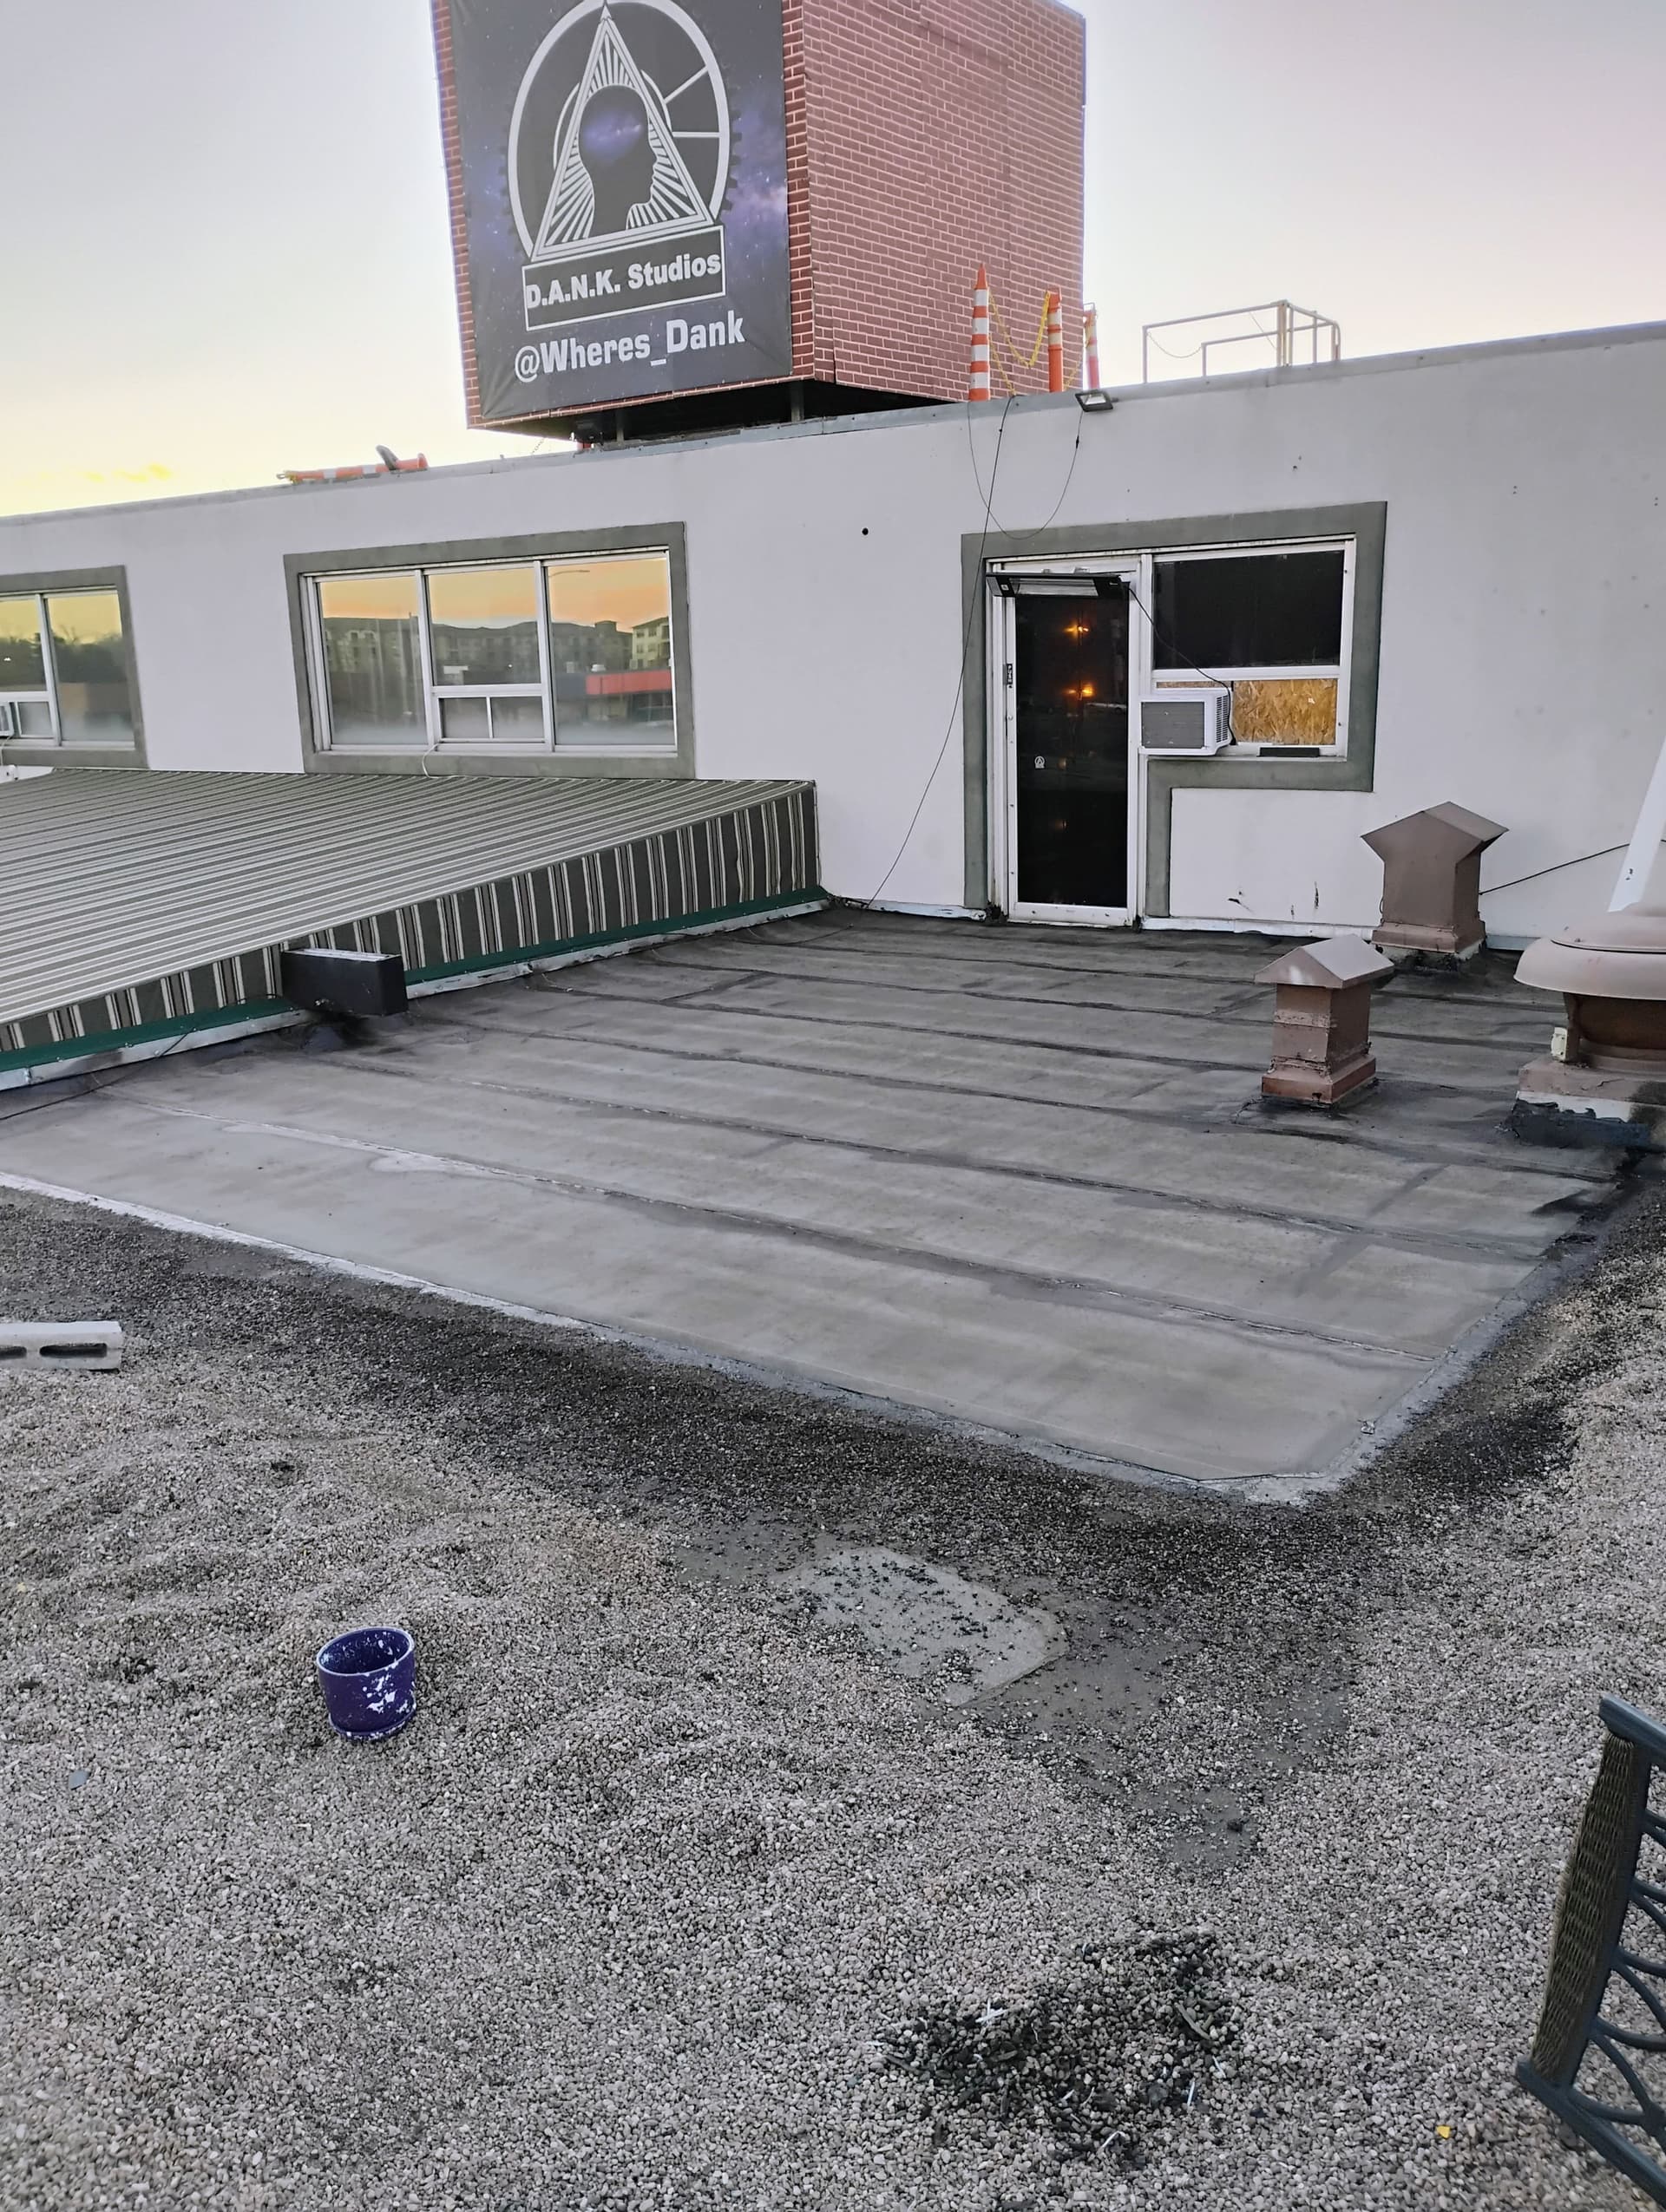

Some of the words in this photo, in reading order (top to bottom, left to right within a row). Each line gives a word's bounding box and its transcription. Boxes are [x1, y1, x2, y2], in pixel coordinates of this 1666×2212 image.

[526, 269, 621, 309] D.A.N.K.
[627, 252, 722, 290] Studios
[515, 310, 745, 383] @Wheres_Dank
